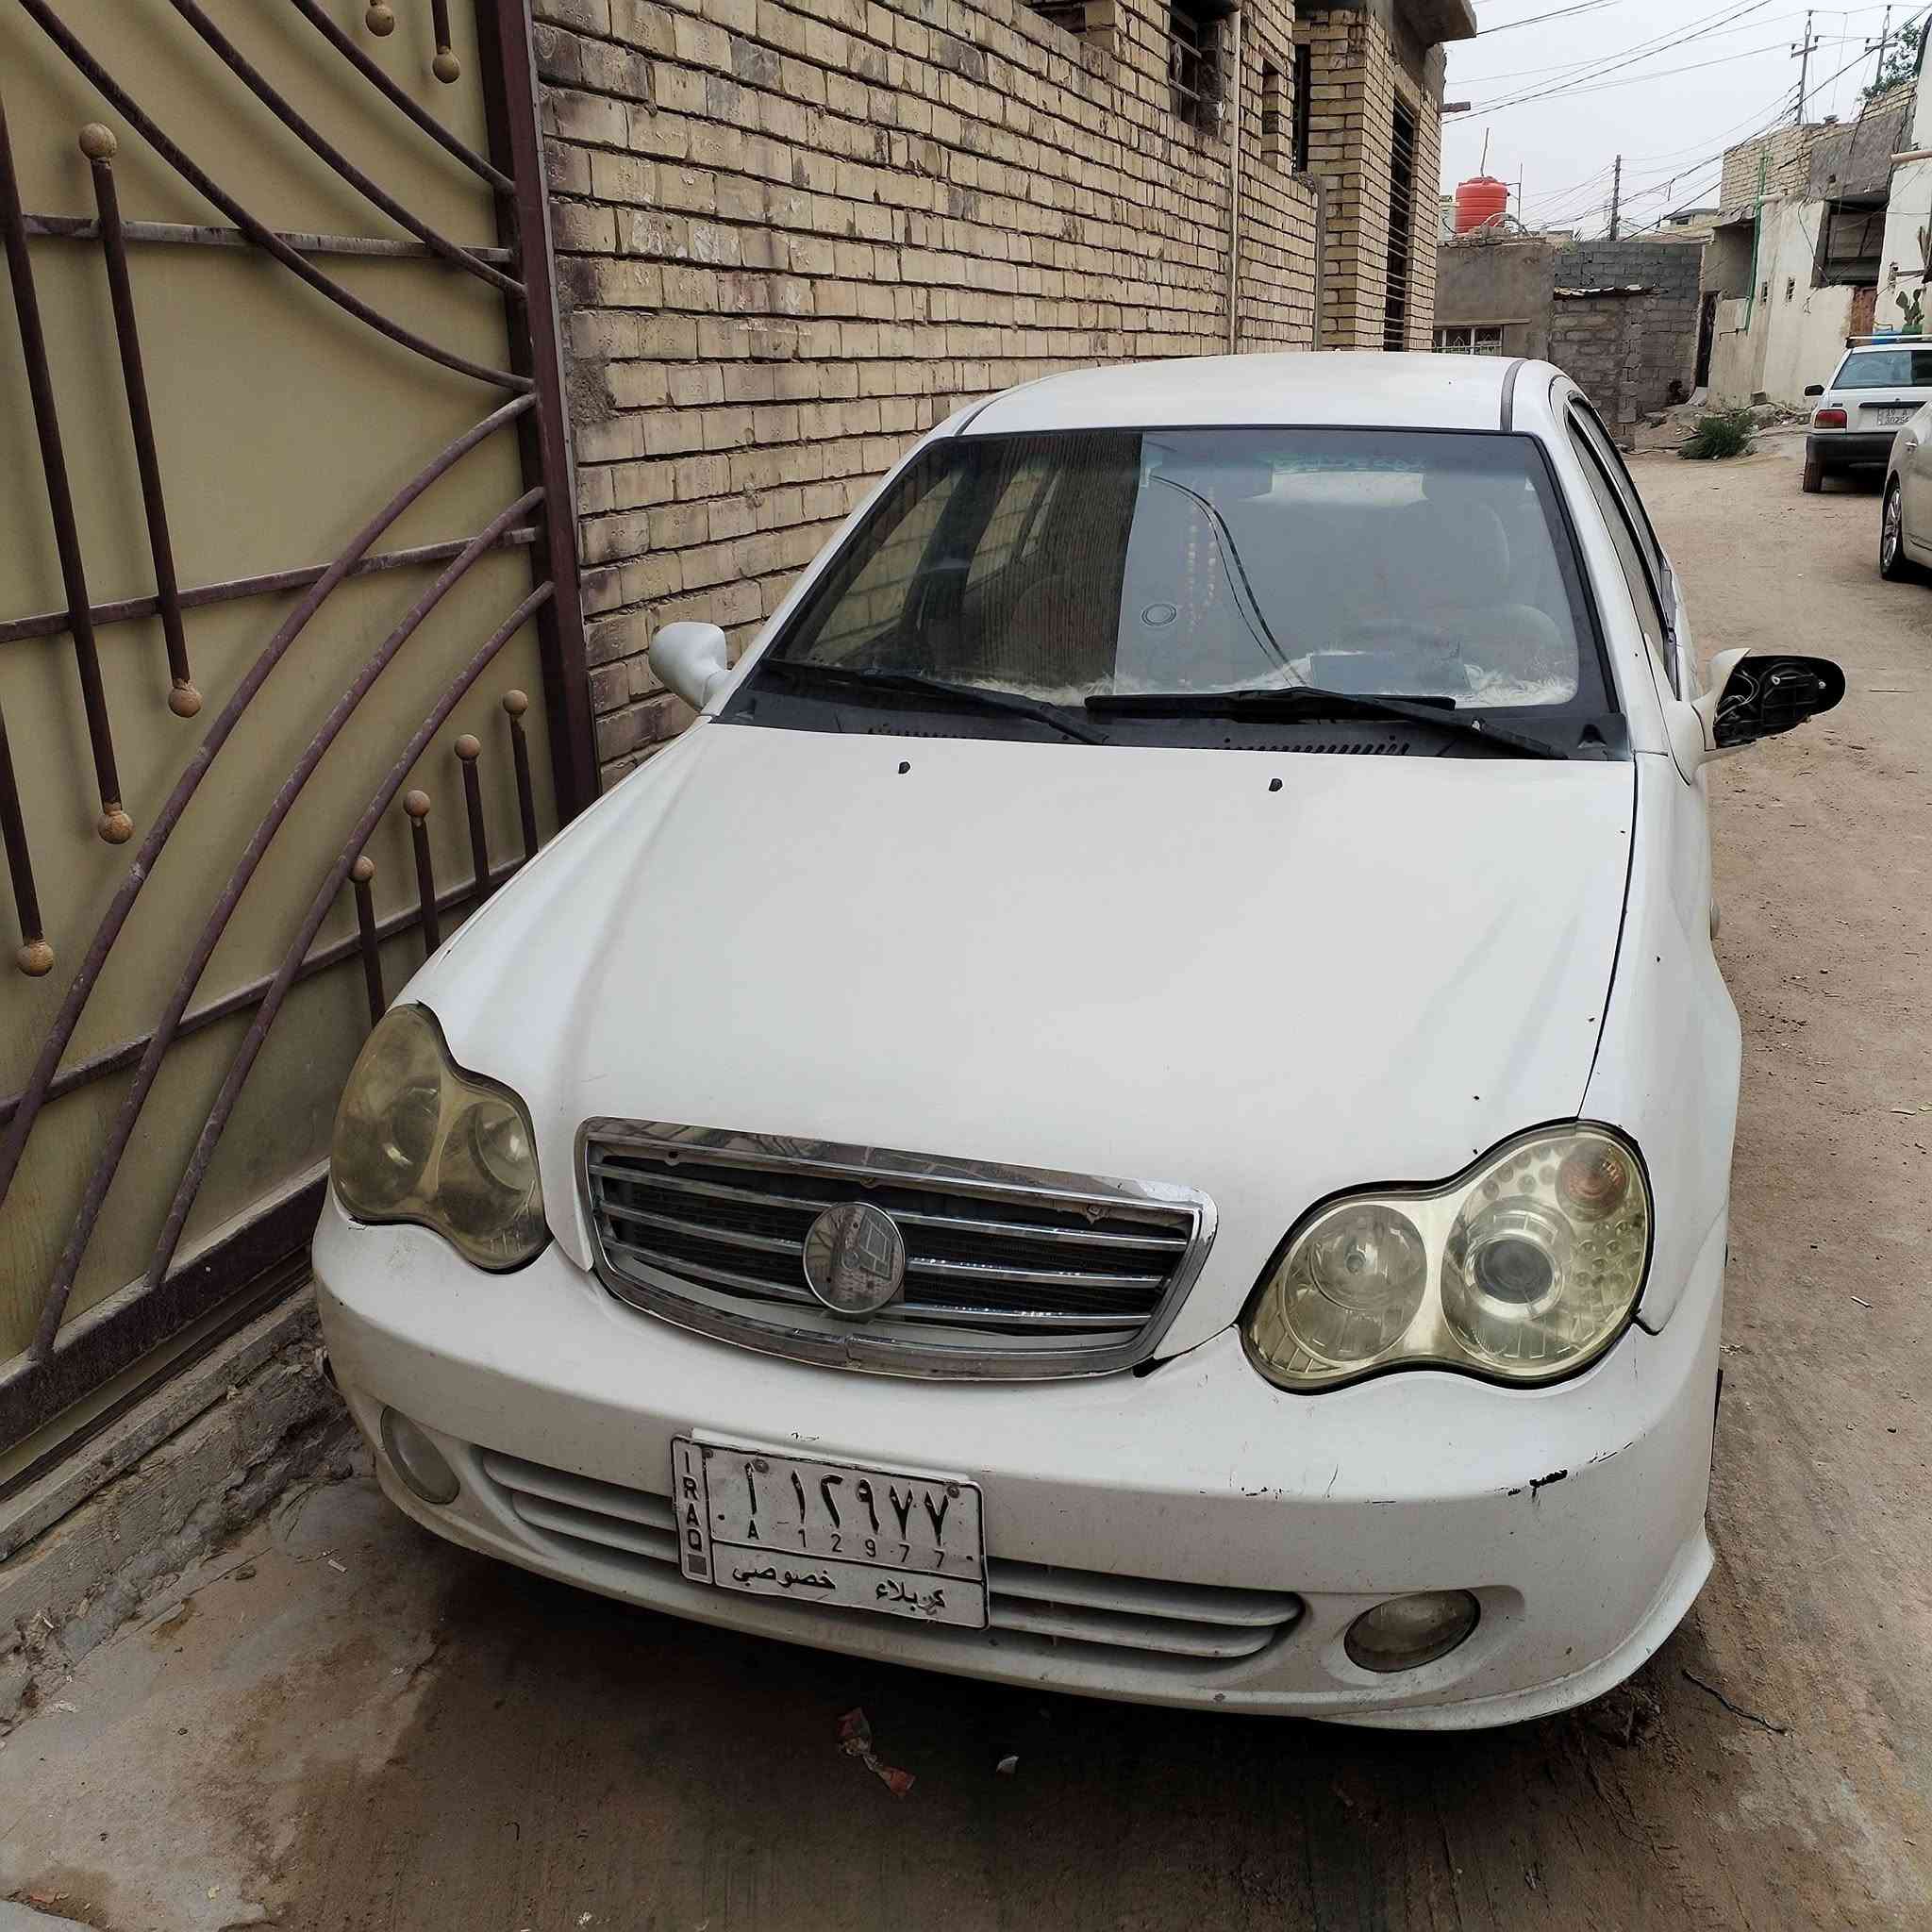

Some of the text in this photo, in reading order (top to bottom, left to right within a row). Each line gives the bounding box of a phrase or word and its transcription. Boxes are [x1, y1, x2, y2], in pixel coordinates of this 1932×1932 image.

[682, 1451, 703, 1552] IRAQ
[746, 1519, 945, 1568] A 12977
[732, 1564, 946, 1613] كربلاء خصوصي
